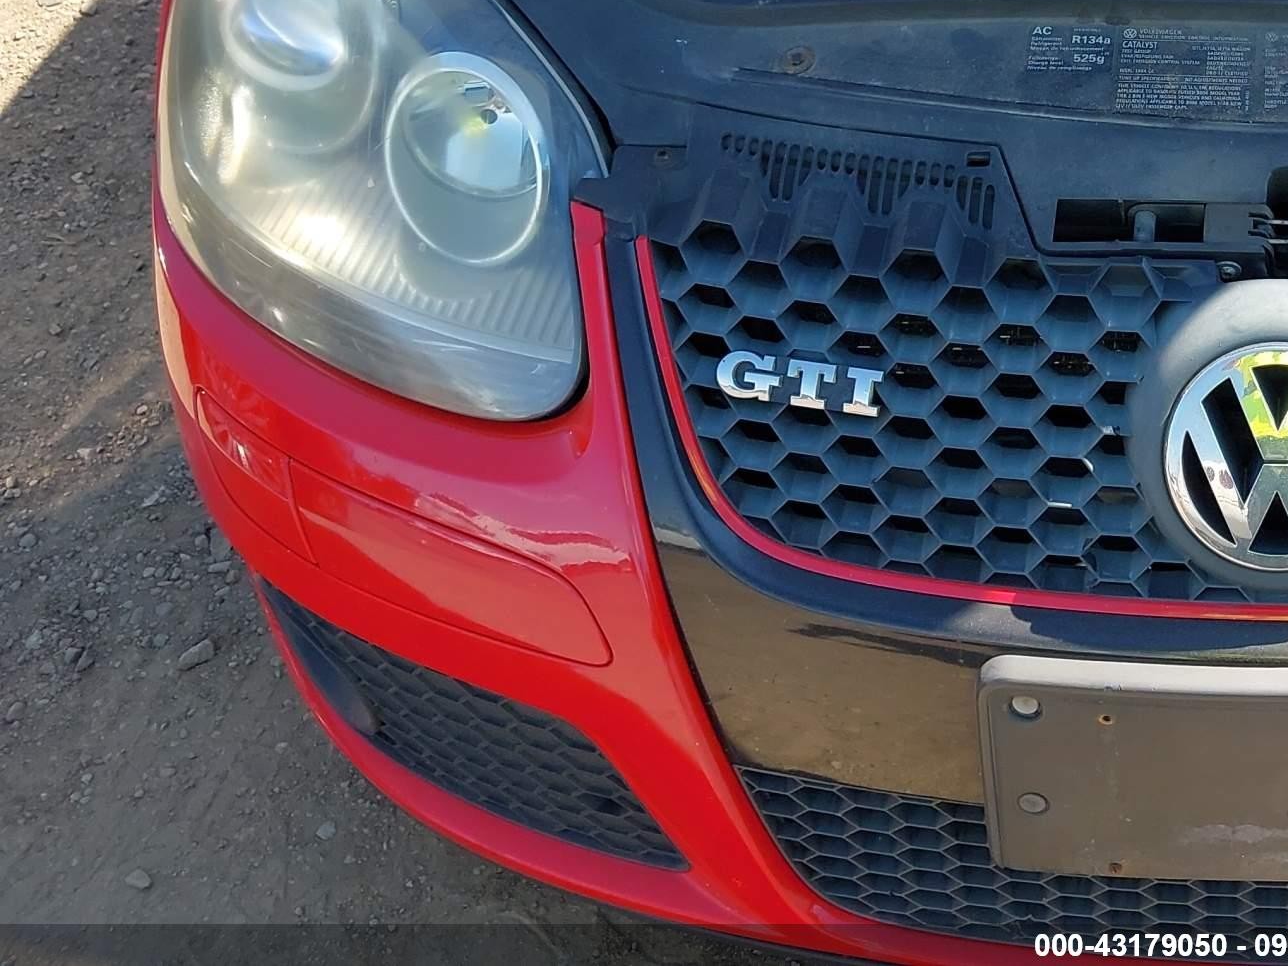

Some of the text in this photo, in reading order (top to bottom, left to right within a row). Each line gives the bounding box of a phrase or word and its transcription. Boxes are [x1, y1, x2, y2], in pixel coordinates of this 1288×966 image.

[1032, 26, 1053, 35] AC
[1072, 35, 1111, 45] R134a
[1122, 40, 1158, 49] CATALYST
[1073, 53, 1104, 65] 525g
[716, 349, 886, 418] GTI
